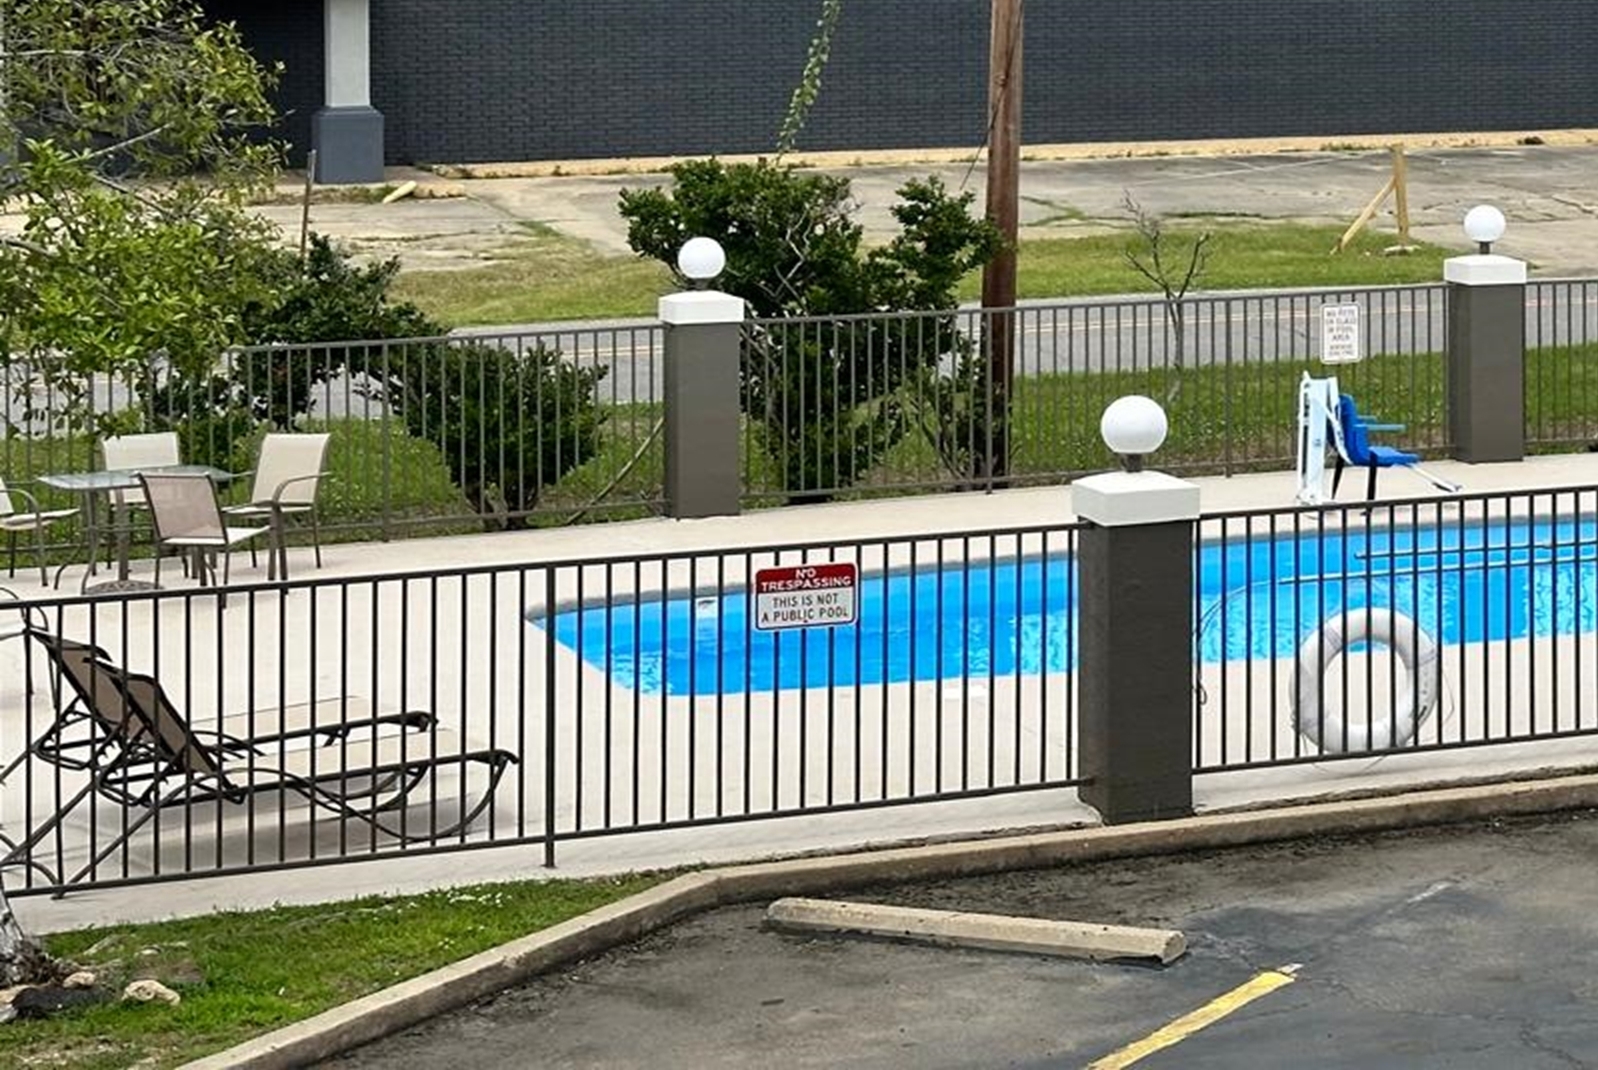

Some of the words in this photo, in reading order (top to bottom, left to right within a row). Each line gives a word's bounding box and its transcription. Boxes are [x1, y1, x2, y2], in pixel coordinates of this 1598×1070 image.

[795, 567, 817, 579] NO
[761, 575, 852, 592] TRESPASSING
[772, 596, 798, 608] THIS
[801, 595, 813, 607] IS
[816, 593, 839, 605] NOT
[761, 612, 769, 623] A
[773, 608, 815, 622] PUBLIC
[819, 606, 849, 618] POOL
